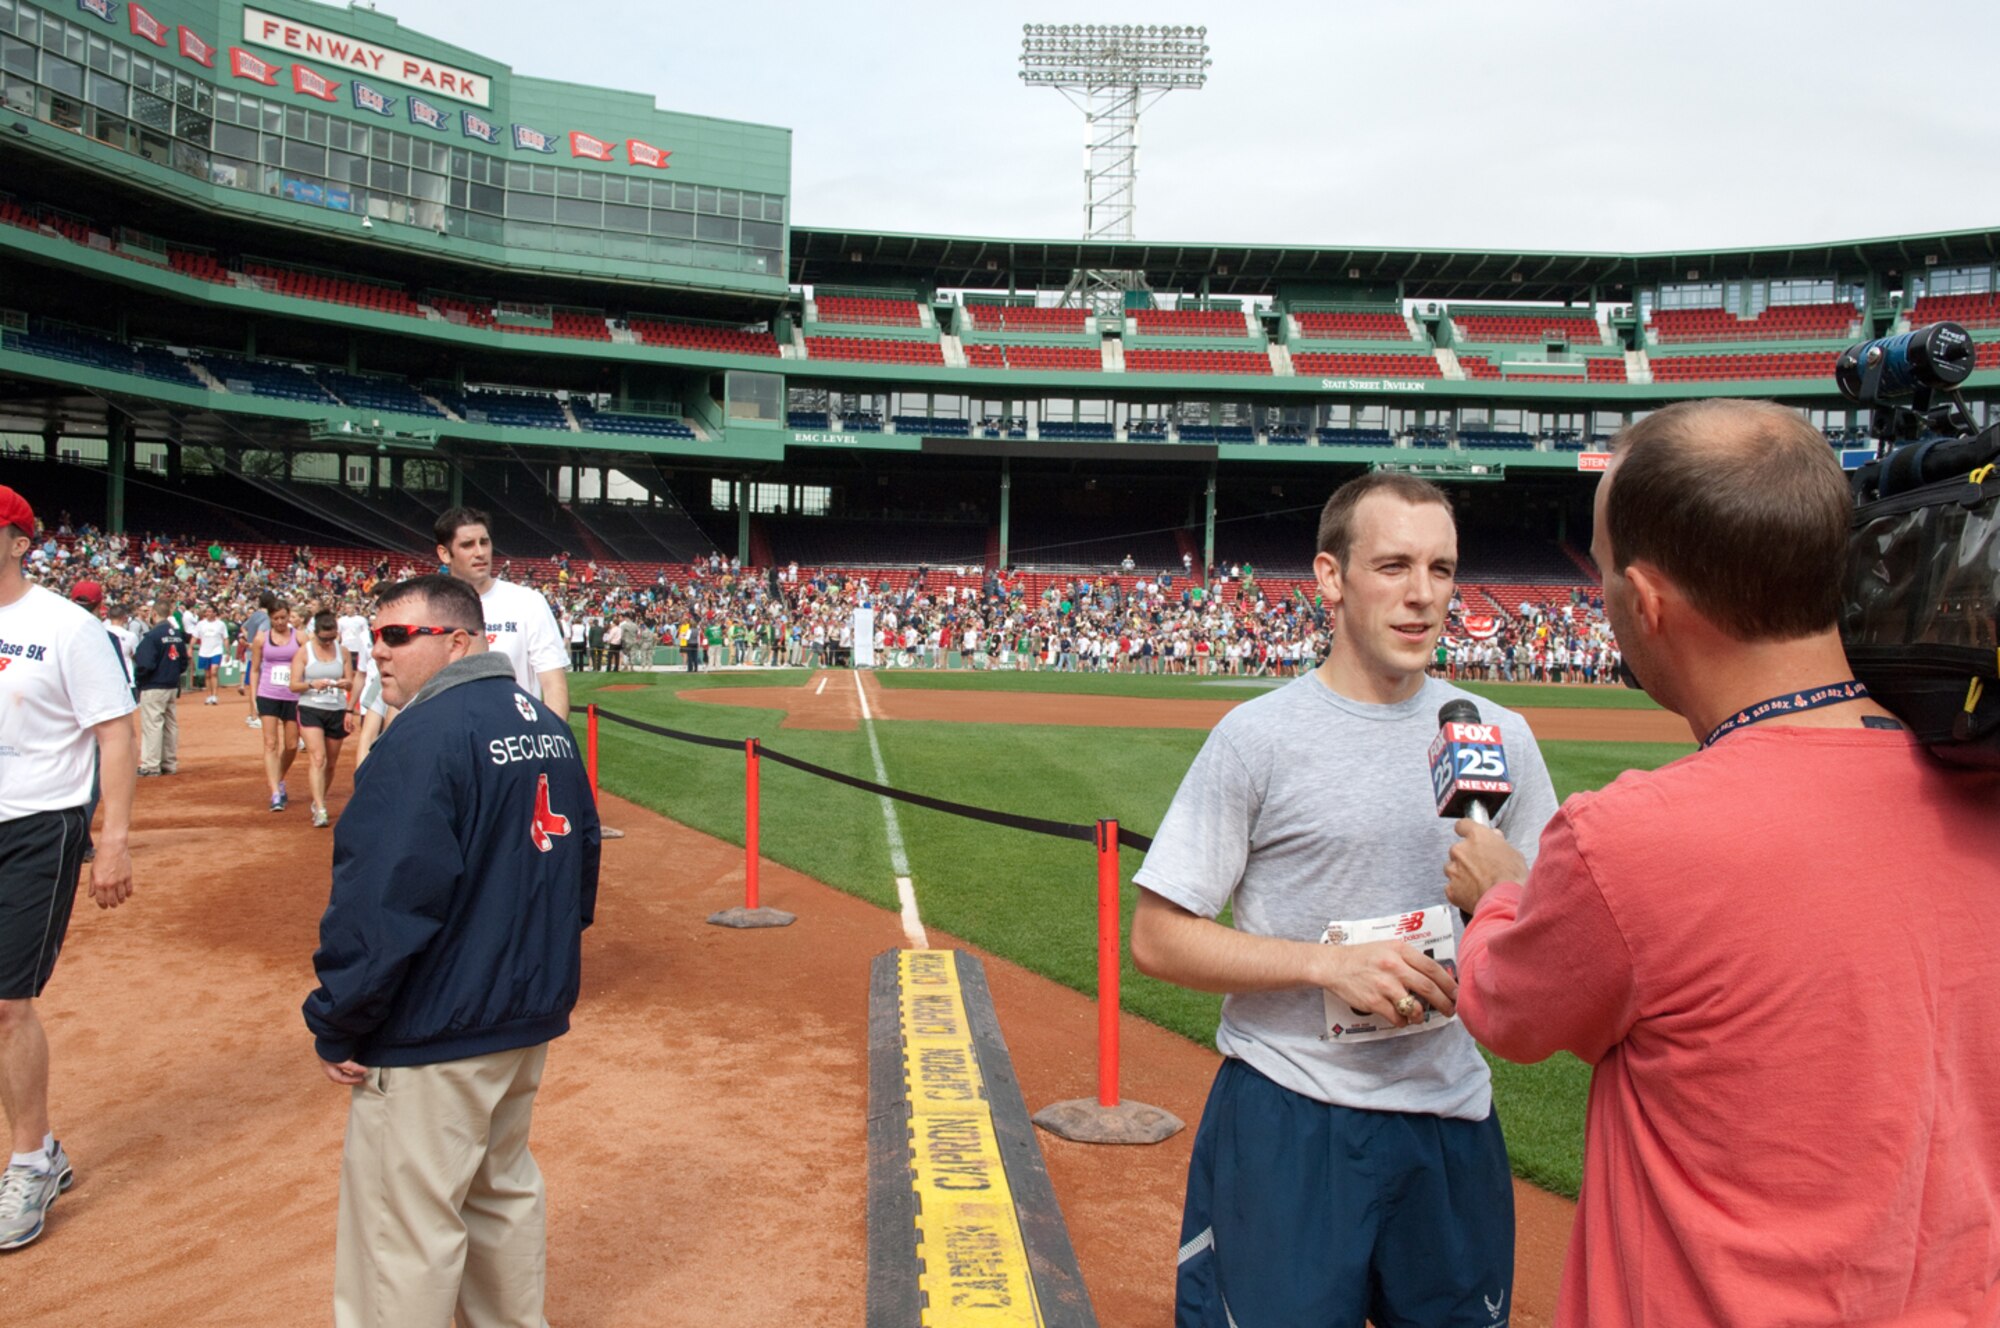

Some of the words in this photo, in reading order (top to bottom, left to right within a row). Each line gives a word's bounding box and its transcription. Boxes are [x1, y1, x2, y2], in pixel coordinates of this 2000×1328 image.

[263, 20, 384, 71] FENWAY
[403, 61, 475, 97] PARK
[1322, 379, 1347, 390] STATE
[1349, 380, 1381, 390] STREET
[1383, 380, 1425, 391] PAVILION
[795, 432, 820, 442] EMC
[823, 434, 858, 444] LEVEL
[505, 621, 518, 632] 9K
[26, 643, 47, 661] 9K
[1810, 690, 1827, 704] RED
[1828, 688, 1844, 698] SOX
[1752, 703, 1770, 718] RED
[1771, 700, 1790, 709] SOX
[1452, 724, 1496, 742] FOX
[489, 734, 574, 765] SECURITY
[1429, 733, 1446, 764] FOX
[1457, 748, 1505, 776] 25
[1435, 752, 1453, 800] 25
[1459, 780, 1509, 791] NEWS
[919, 1048, 974, 1100] CAPRON
[926, 1118, 991, 1190] CAPRON
